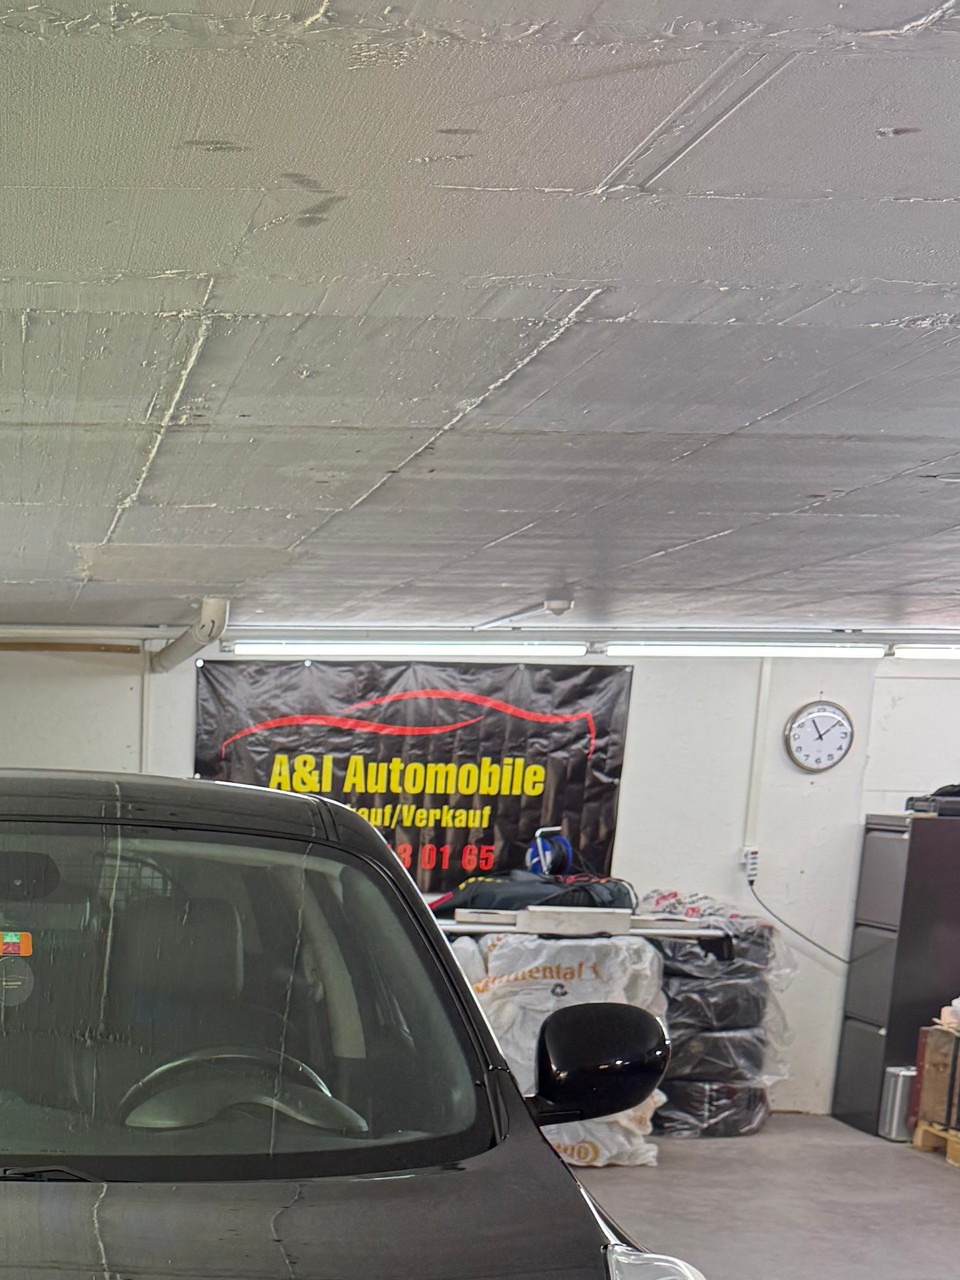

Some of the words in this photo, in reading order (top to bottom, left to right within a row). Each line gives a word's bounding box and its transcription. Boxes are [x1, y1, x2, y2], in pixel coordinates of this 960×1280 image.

[269, 754, 333, 793] A&I
[343, 755, 546, 796] Automobile
[346, 804, 491, 829] auf/Verkauf
[420, 844, 451, 870] 01
[461, 844, 495, 871] 65
